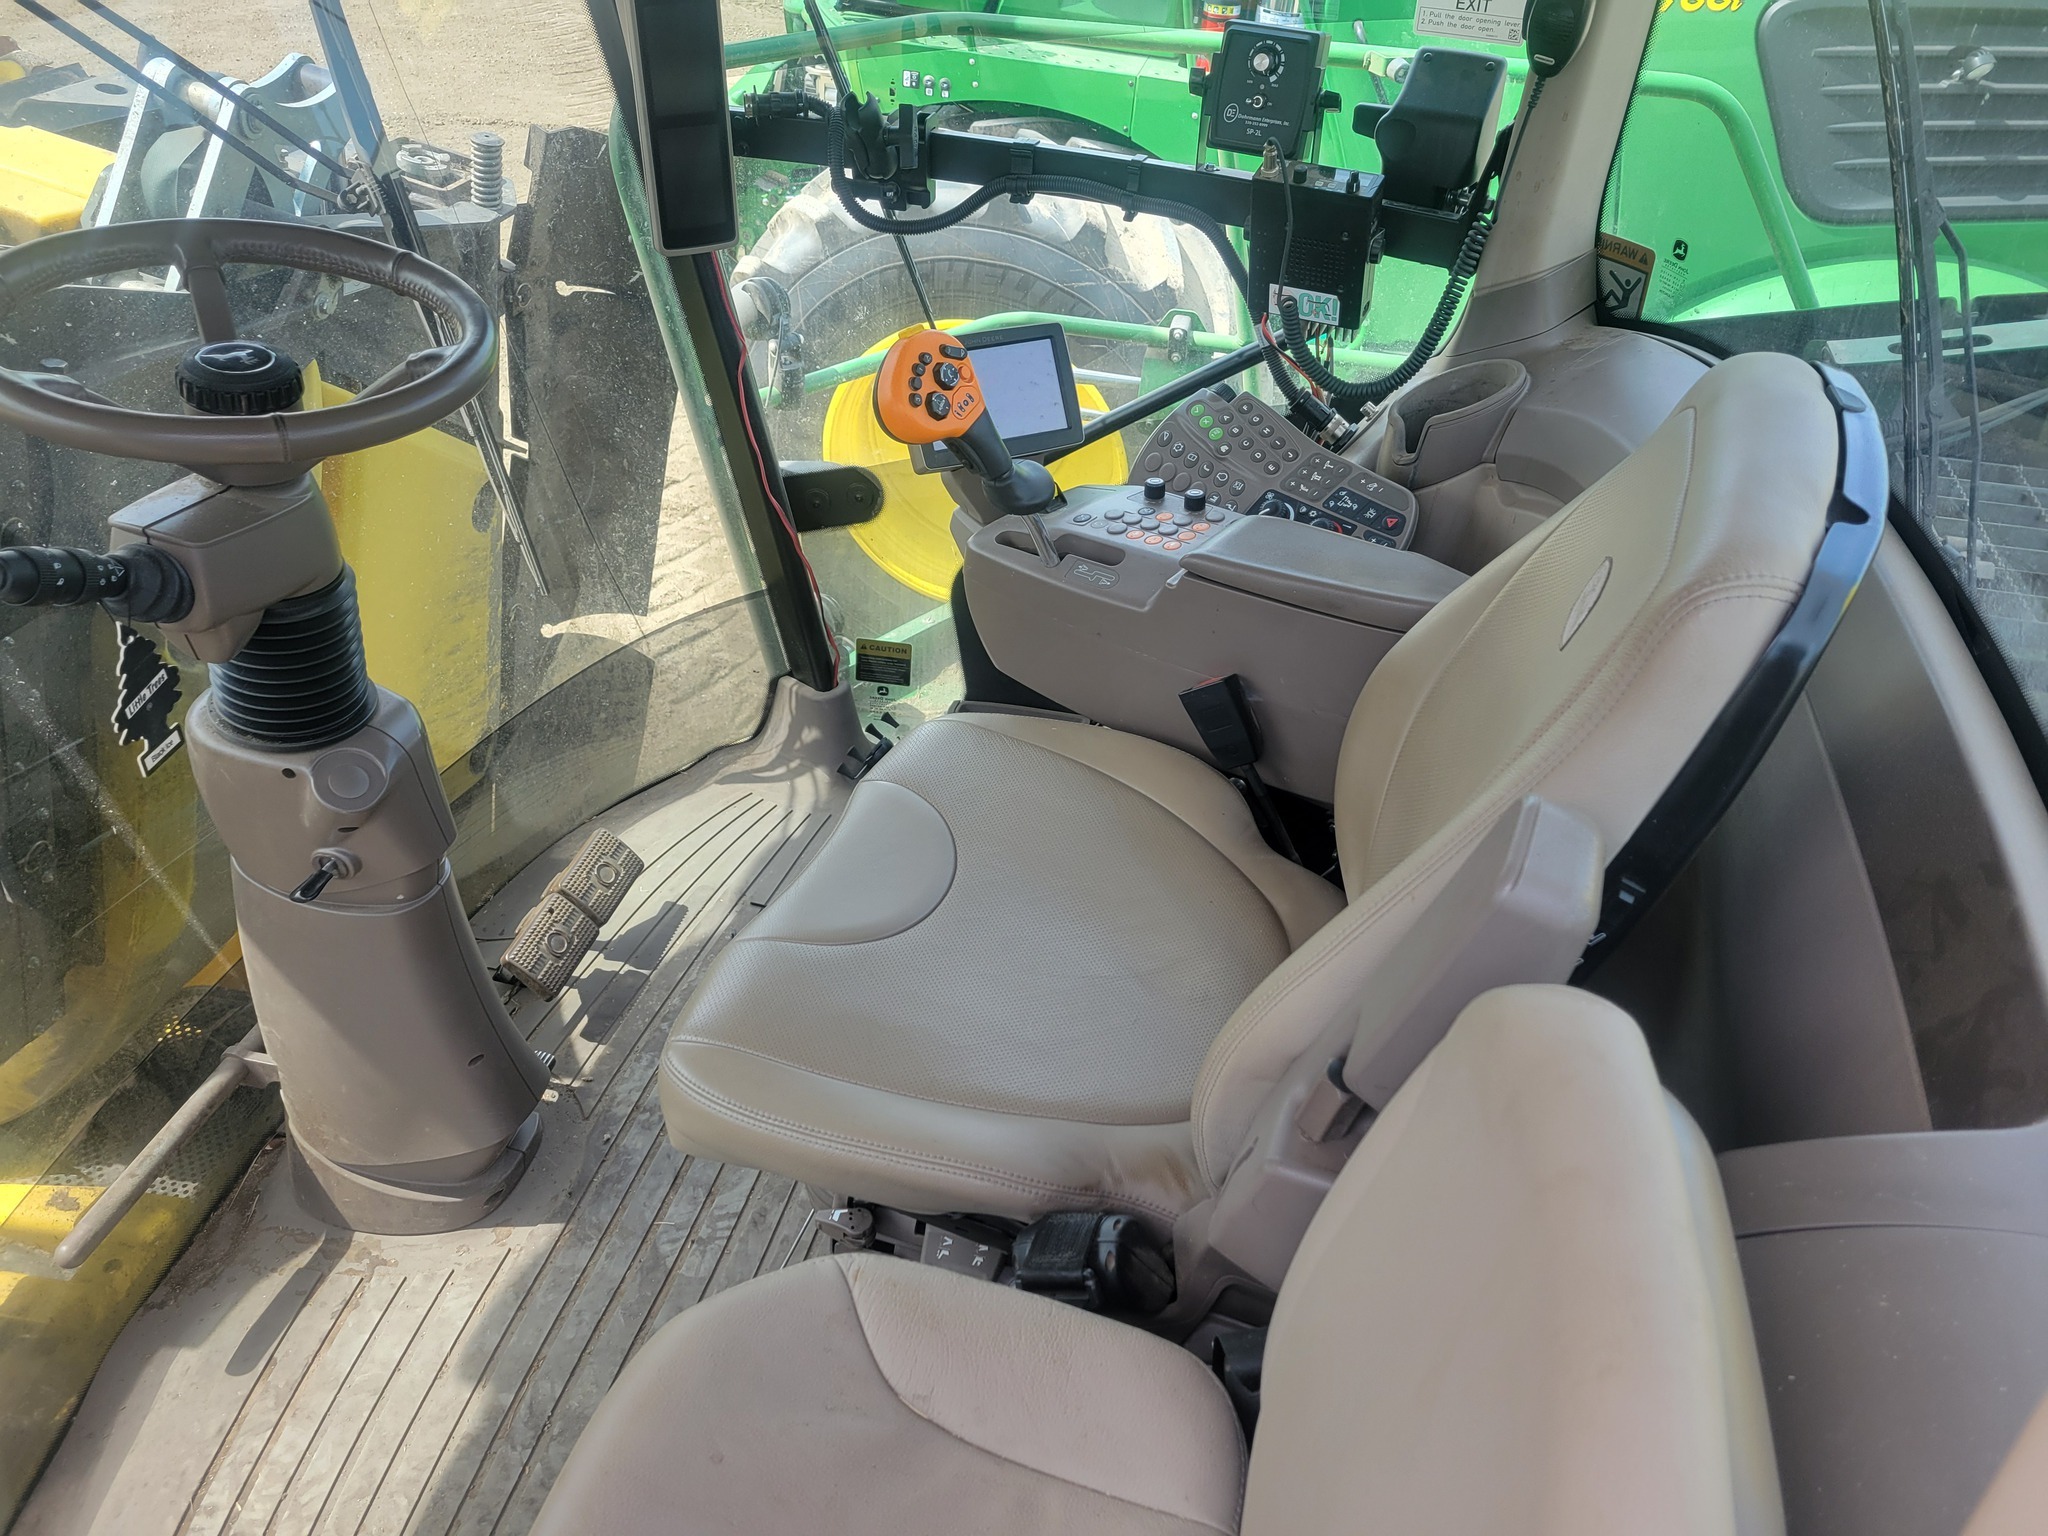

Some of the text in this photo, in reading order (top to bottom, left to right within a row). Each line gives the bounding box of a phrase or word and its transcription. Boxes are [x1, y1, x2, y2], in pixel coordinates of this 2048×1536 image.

[1456, 0, 1492, 13] EXIT
[1428, 18, 1444, 27] Push
[1447, 20, 1457, 28] the
[1460, 21, 1475, 30] door
[1429, 10, 1442, 18] Pull
[1444, 12, 1455, 20] the
[1458, 13, 1473, 22] door
[1475, 17, 1501, 26] opening
[869, 644, 907, 654] CAUTION
[128, 673, 166, 716] Little Trees
